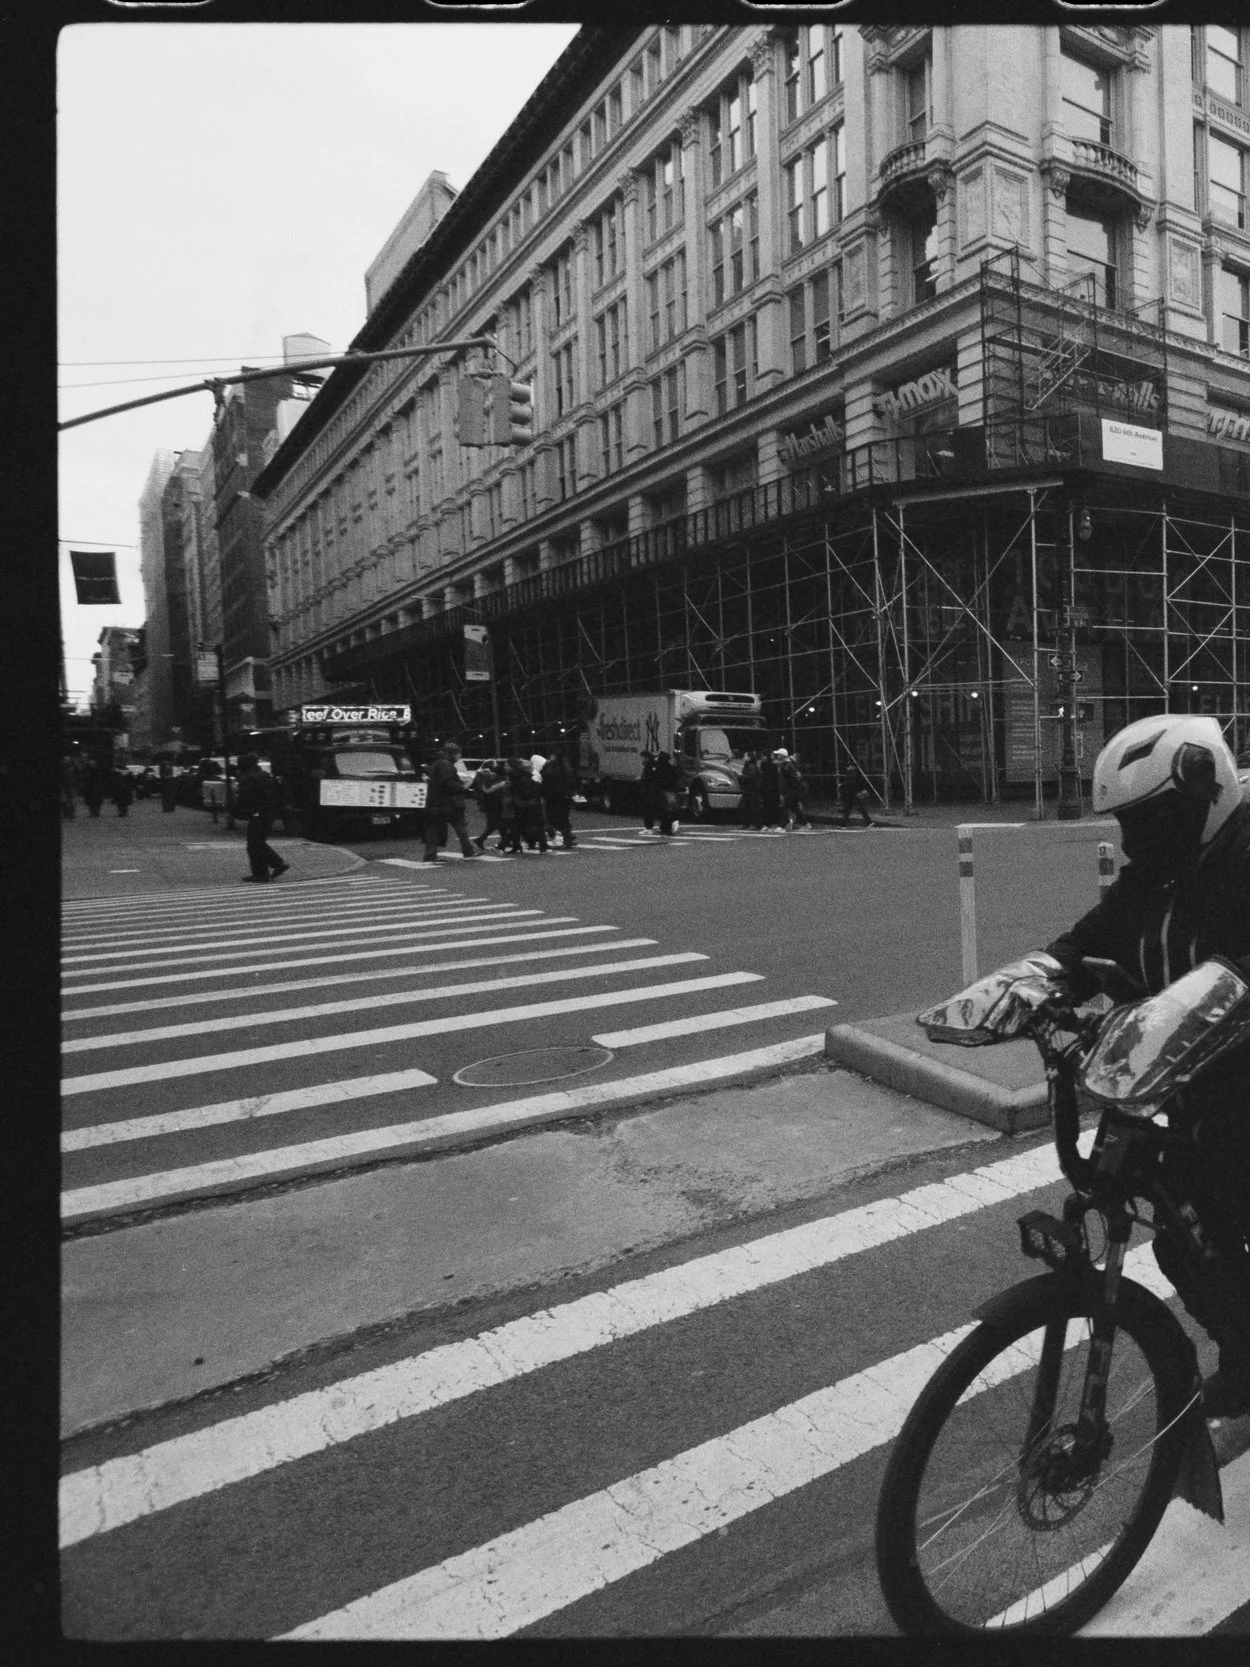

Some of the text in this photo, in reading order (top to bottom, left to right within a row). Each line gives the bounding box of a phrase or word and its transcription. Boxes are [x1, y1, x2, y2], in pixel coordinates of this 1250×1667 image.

[1135, 431, 1157, 441] Avenue
[332, 708, 365, 720] Over
[368, 708, 397, 720] Rice
